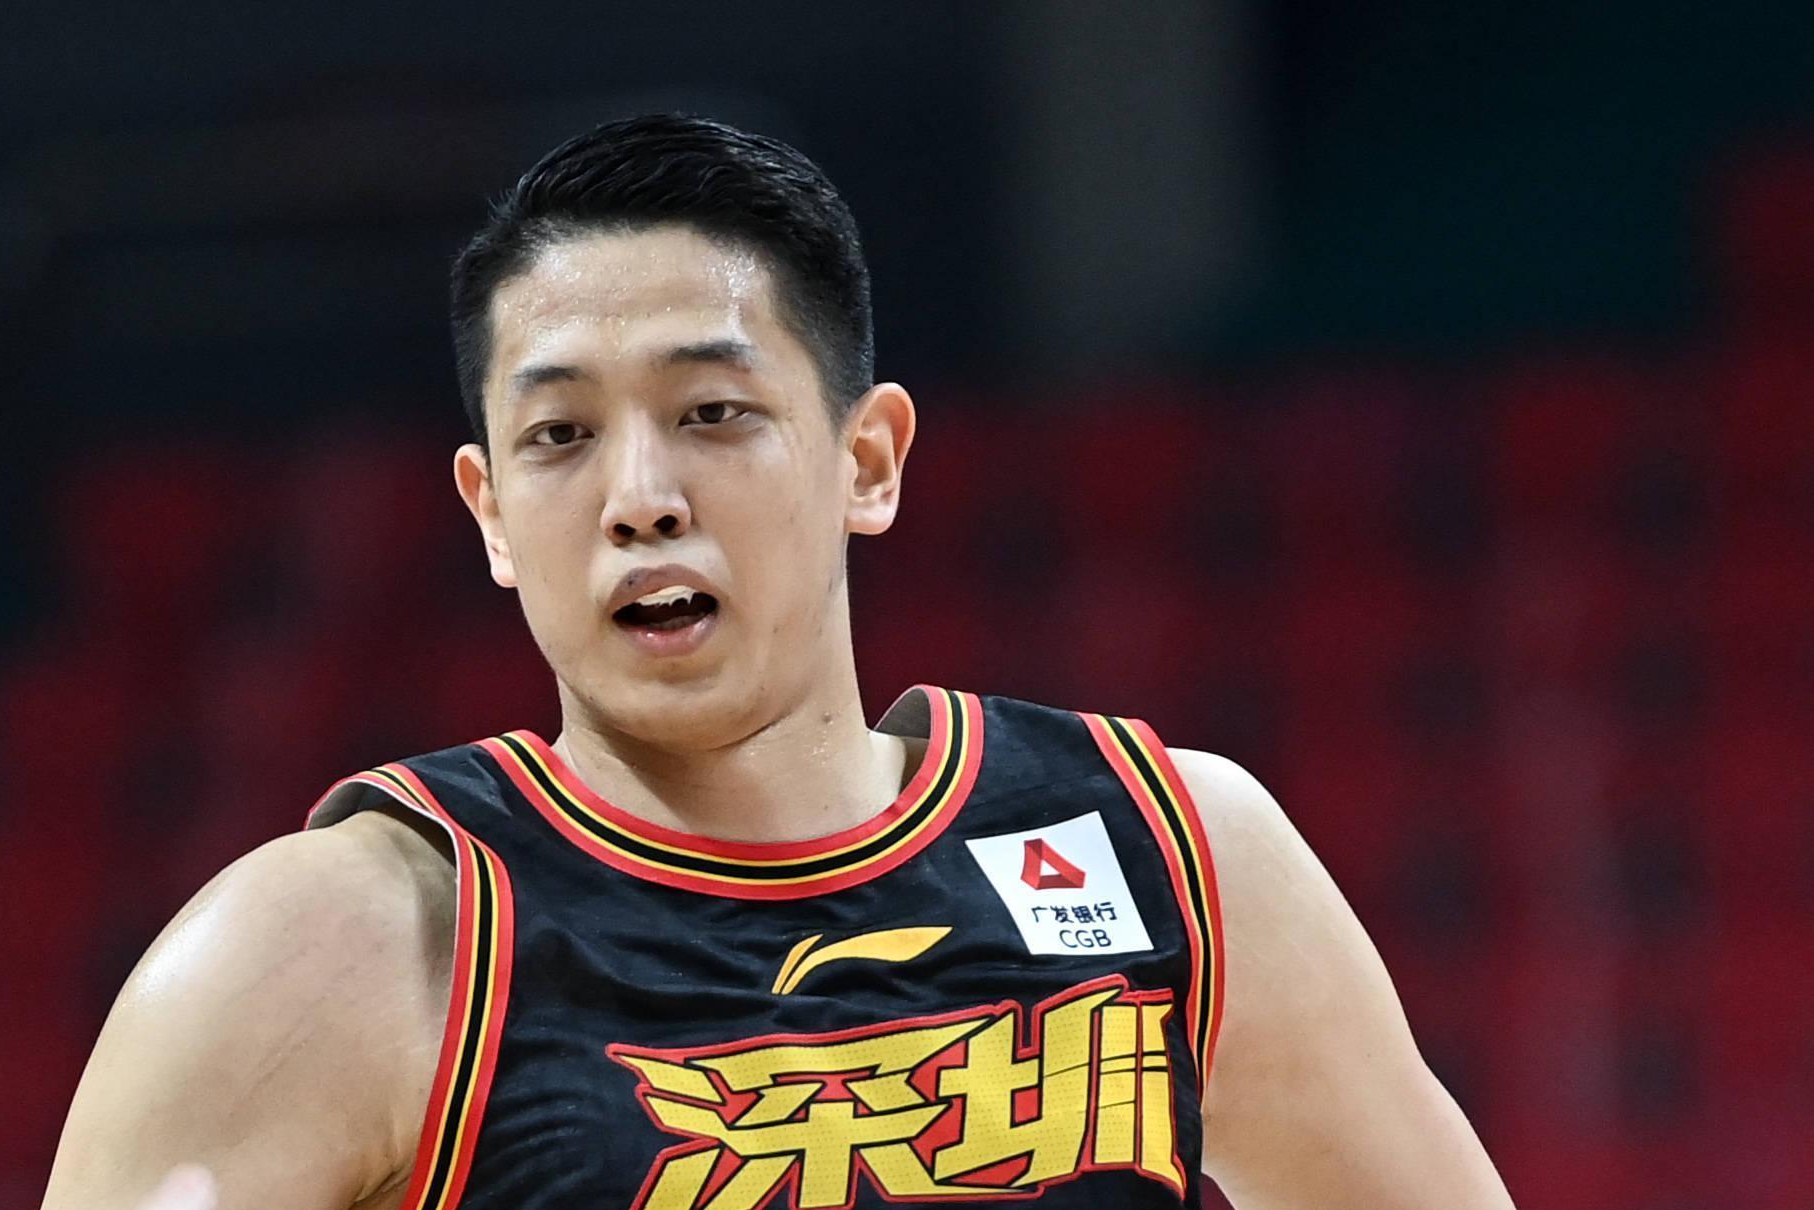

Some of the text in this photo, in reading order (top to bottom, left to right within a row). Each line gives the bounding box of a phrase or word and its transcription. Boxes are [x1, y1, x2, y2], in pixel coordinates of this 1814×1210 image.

[1031, 902, 1117, 923] 广发银行
[1059, 929, 1112, 948] CGB
